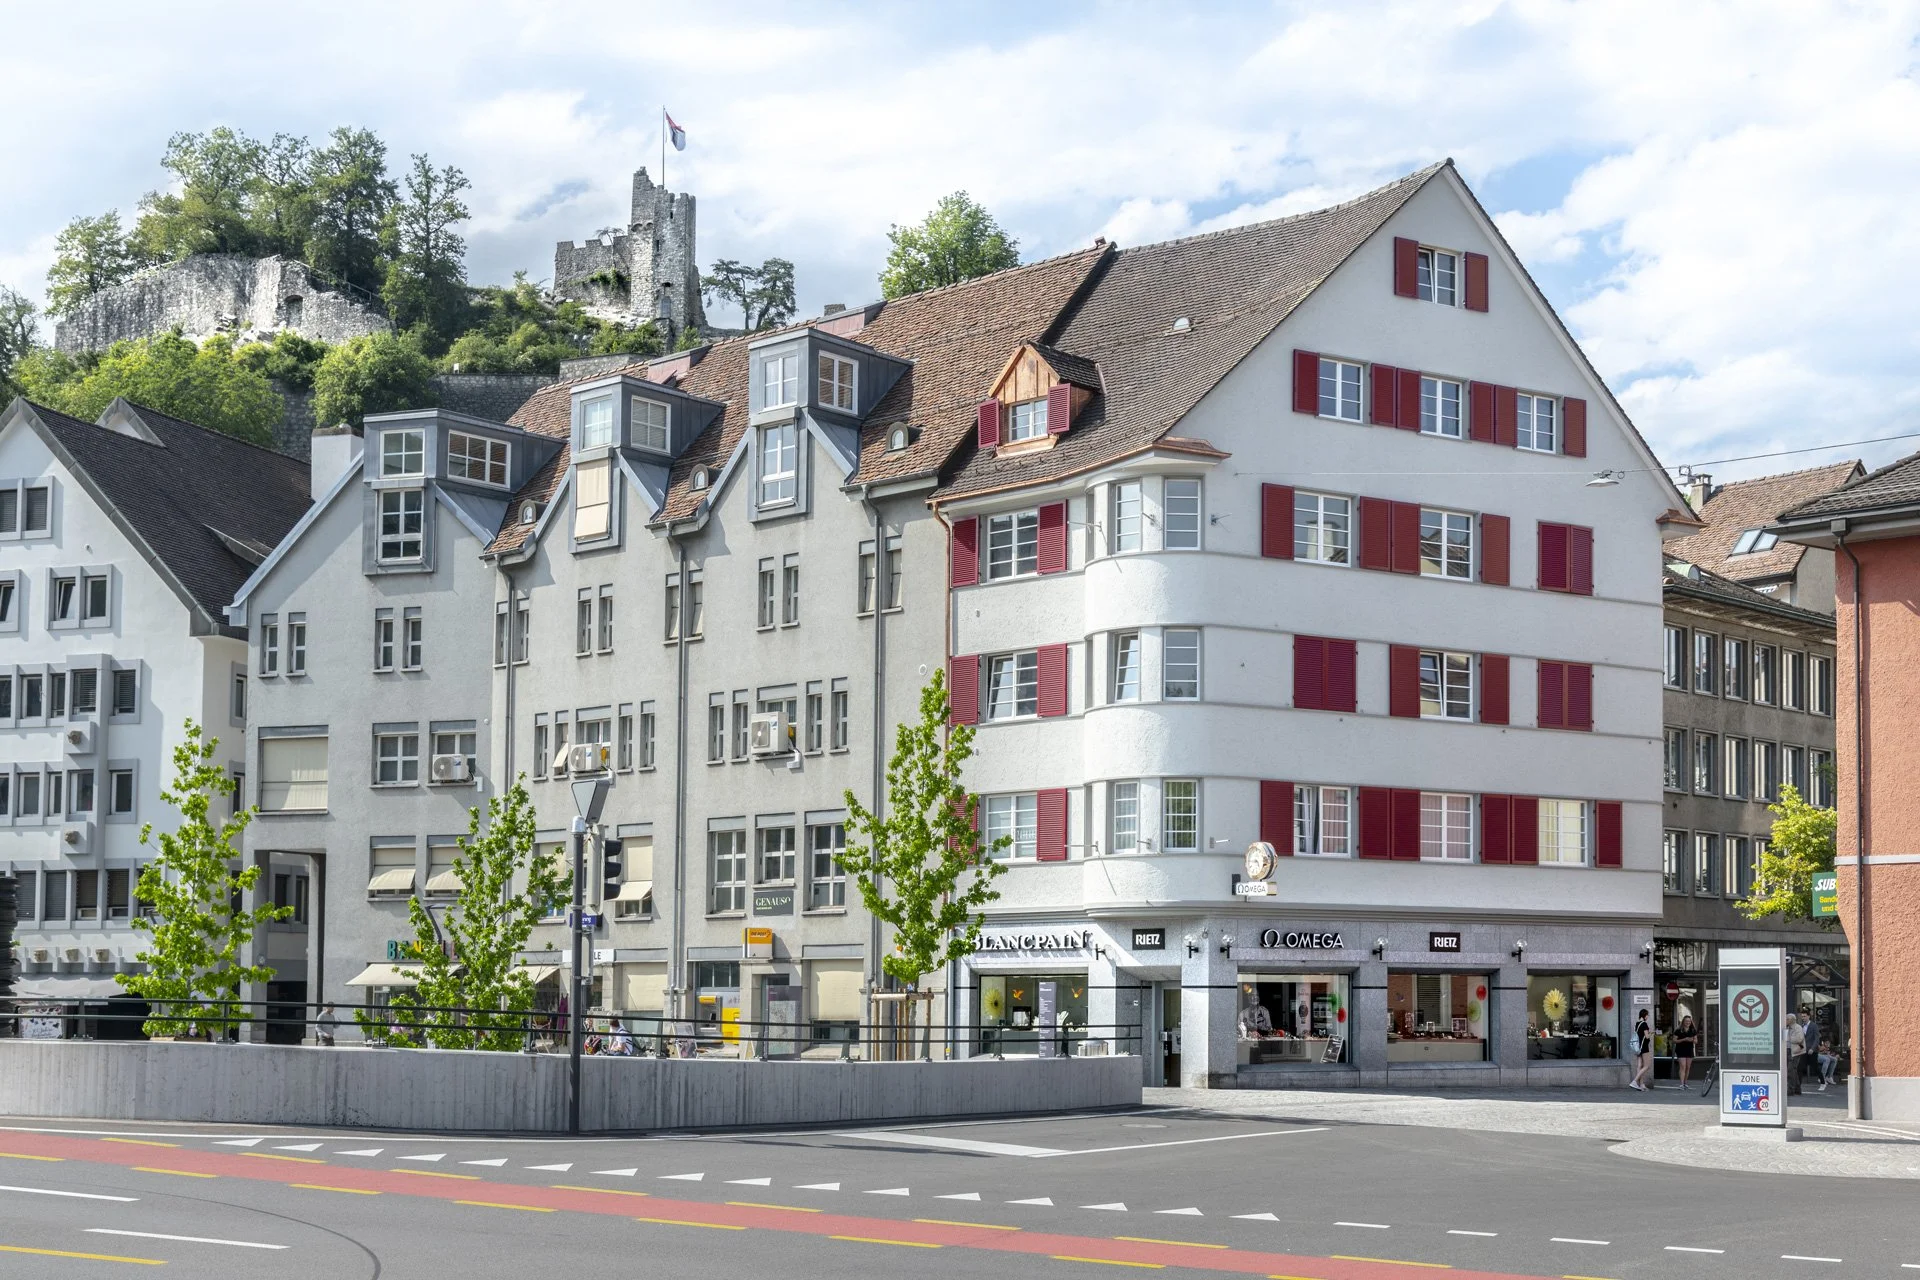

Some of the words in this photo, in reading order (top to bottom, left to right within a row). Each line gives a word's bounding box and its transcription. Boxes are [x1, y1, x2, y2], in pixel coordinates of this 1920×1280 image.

[1244, 885, 1266, 893] OMEGA
[1814, 878, 1838, 892] SUB
[755, 896, 791, 905] GENAUSO
[970, 931, 1088, 950] BLANCPAIN
[1135, 933, 1161, 945] RIETZ
[1285, 932, 1345, 949] OMEGA
[1433, 936, 1458, 948] RIETZ
[1740, 1075, 1761, 1083] ZONE
